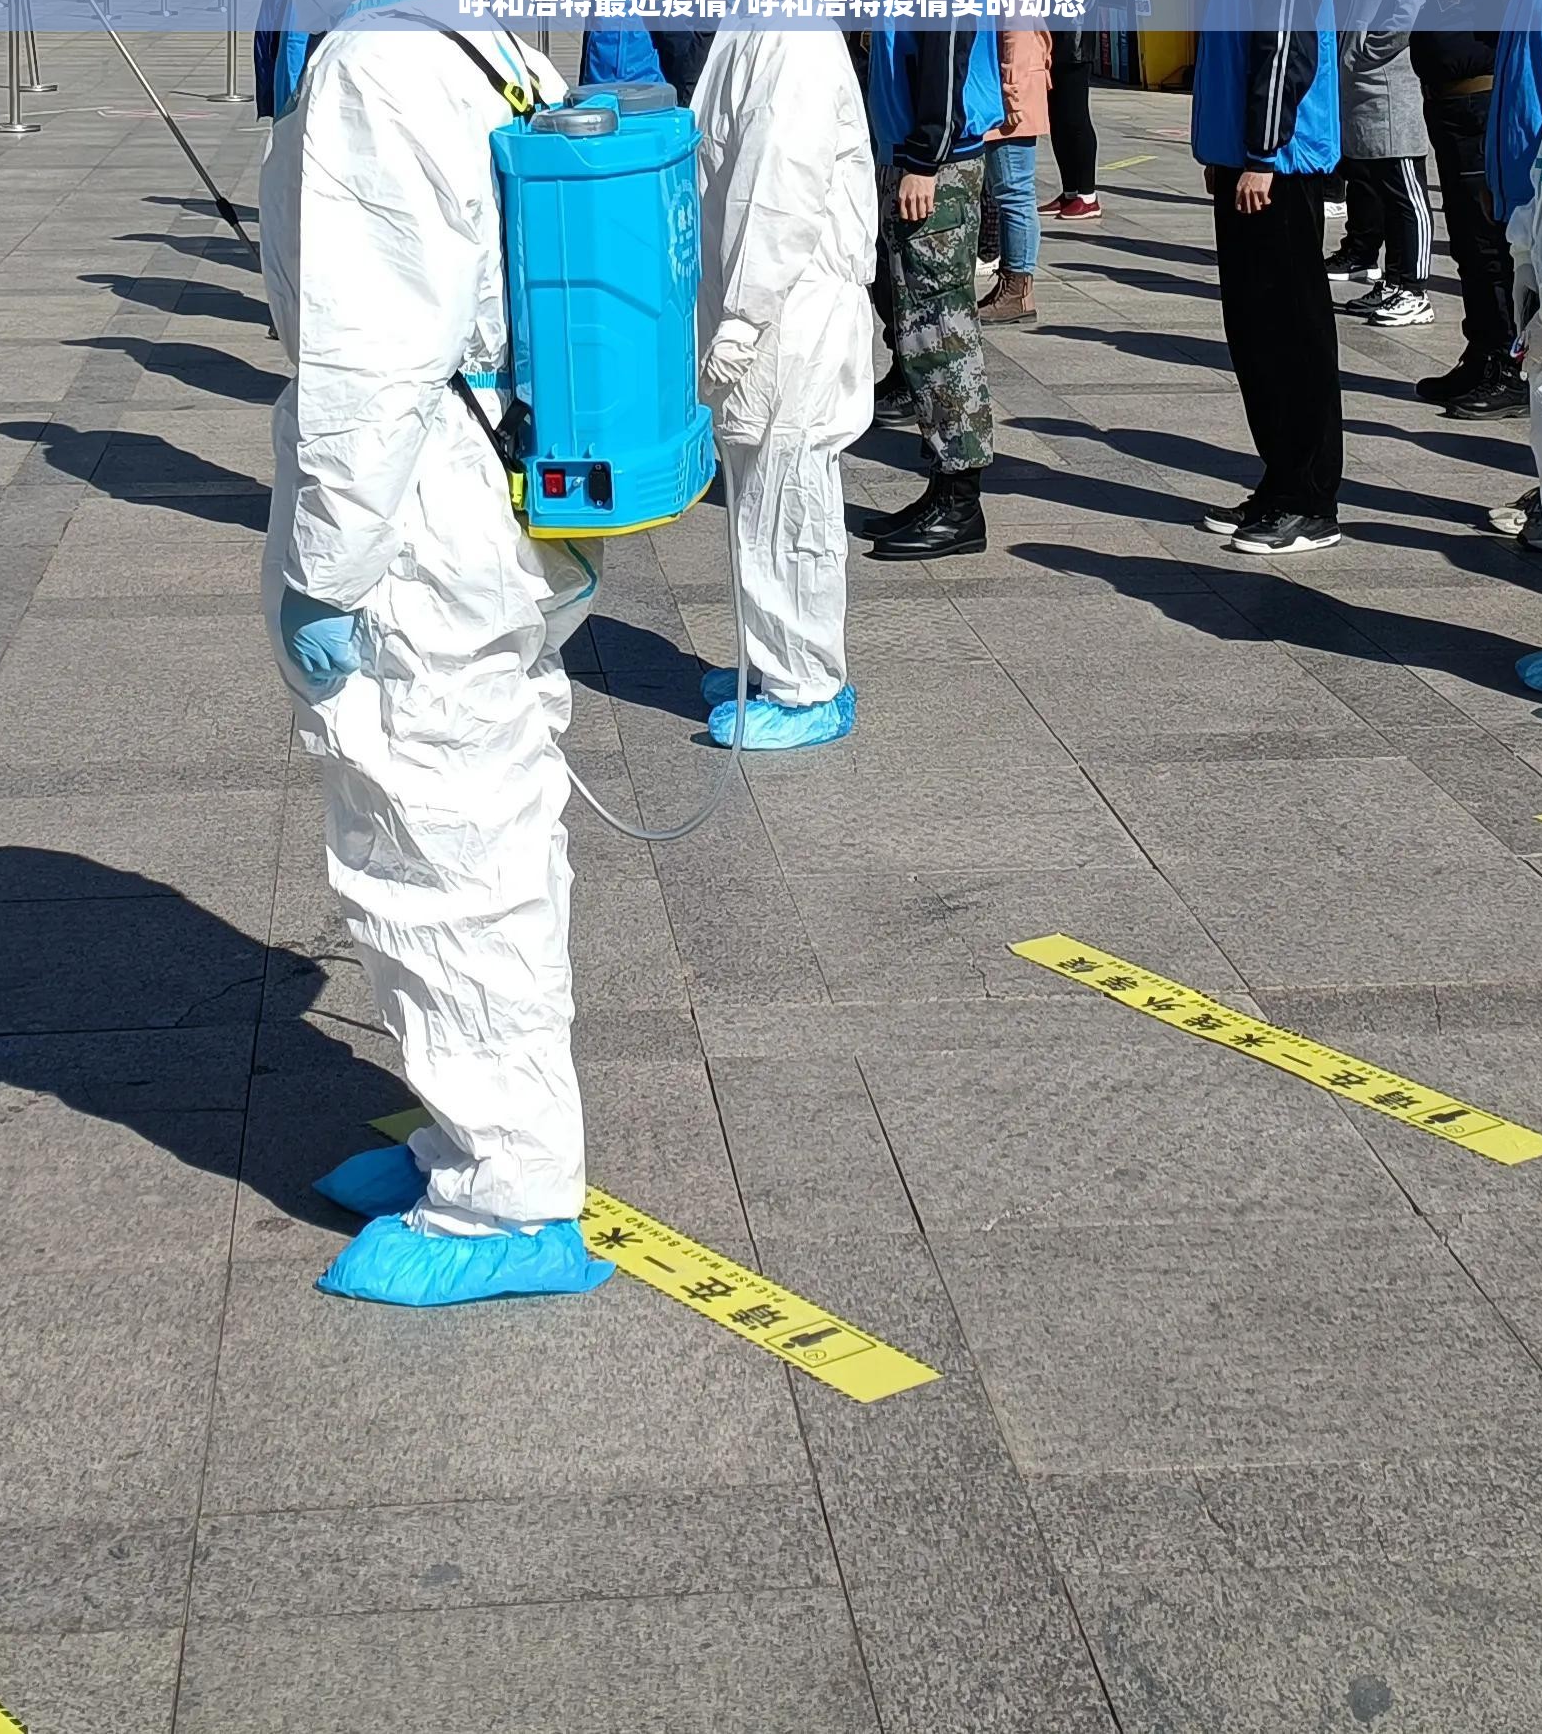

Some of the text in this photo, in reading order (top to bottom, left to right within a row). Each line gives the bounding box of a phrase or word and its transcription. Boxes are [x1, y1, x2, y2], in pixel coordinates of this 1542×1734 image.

[1057, 956, 1422, 1111] 请在一米线外等候
[592, 1198, 787, 1303] PLEASE WAIT BEHIND THE
